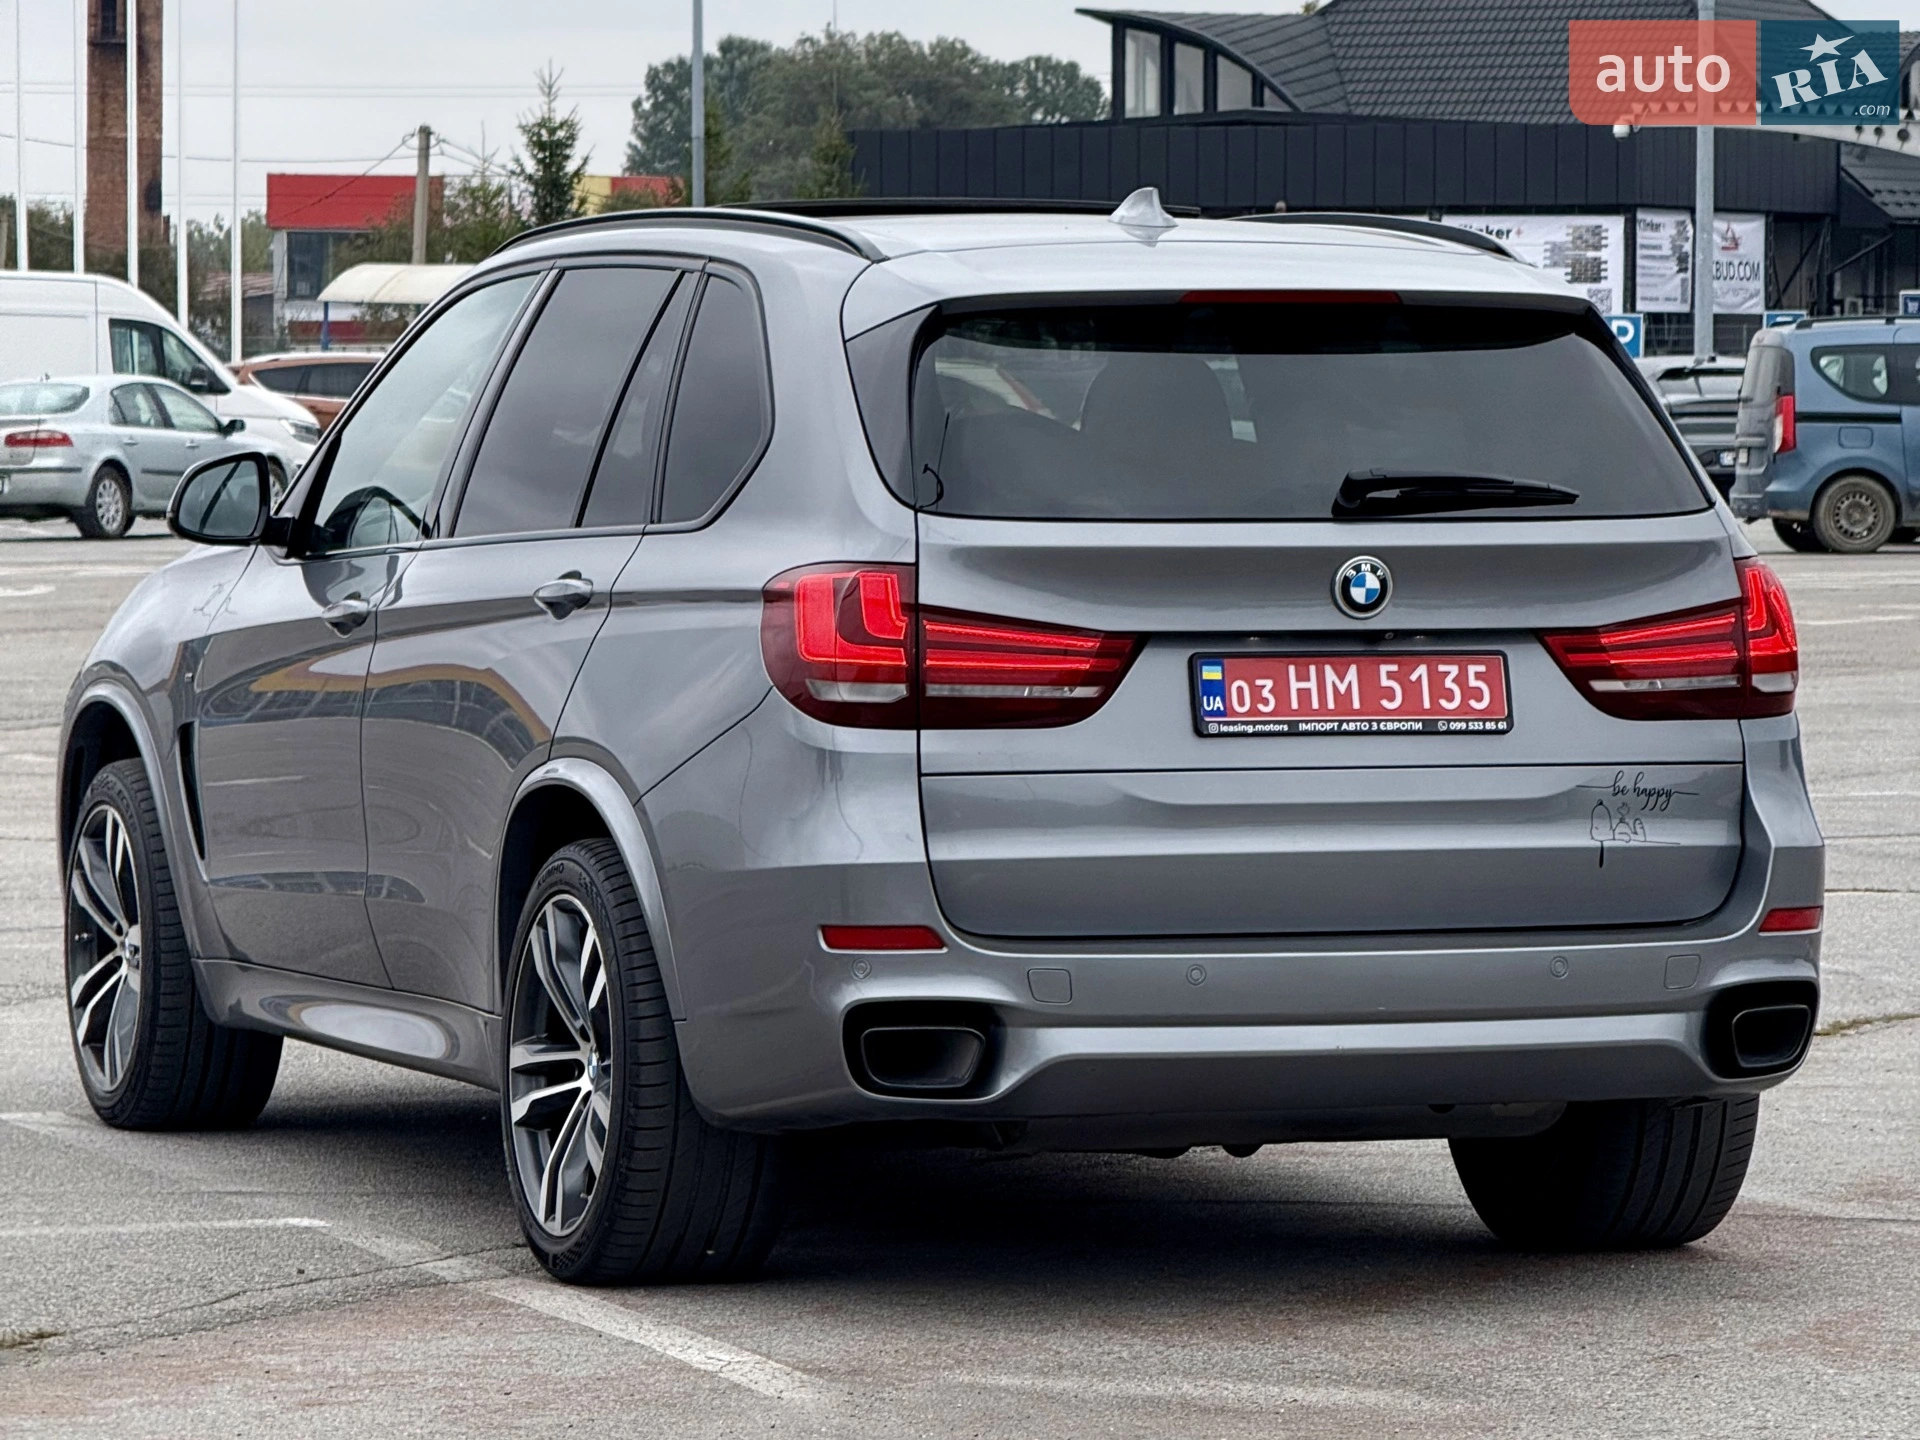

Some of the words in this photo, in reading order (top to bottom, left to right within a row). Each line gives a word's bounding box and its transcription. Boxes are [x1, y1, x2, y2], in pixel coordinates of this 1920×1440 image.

[1713, 261, 1761, 281] BUD.COM
[1230, 679, 1276, 713] 03
[1288, 664, 1361, 710] HM
[1379, 664, 1491, 710] 5135
[1203, 695, 1224, 711] UA
[1220, 723, 1289, 733] leasing.motors
[1299, 722, 1339, 731] ІМПОРТ
[1341, 722, 1369, 731] АВТО
[1380, 721, 1423, 731] ЄВРОПИ
[1449, 721, 1467, 730] 099
[1468, 721, 1483, 730] 533
[1485, 721, 1496, 730] 85
[1498, 721, 1507, 730] 61
[1632, 771, 1699, 812] happy
